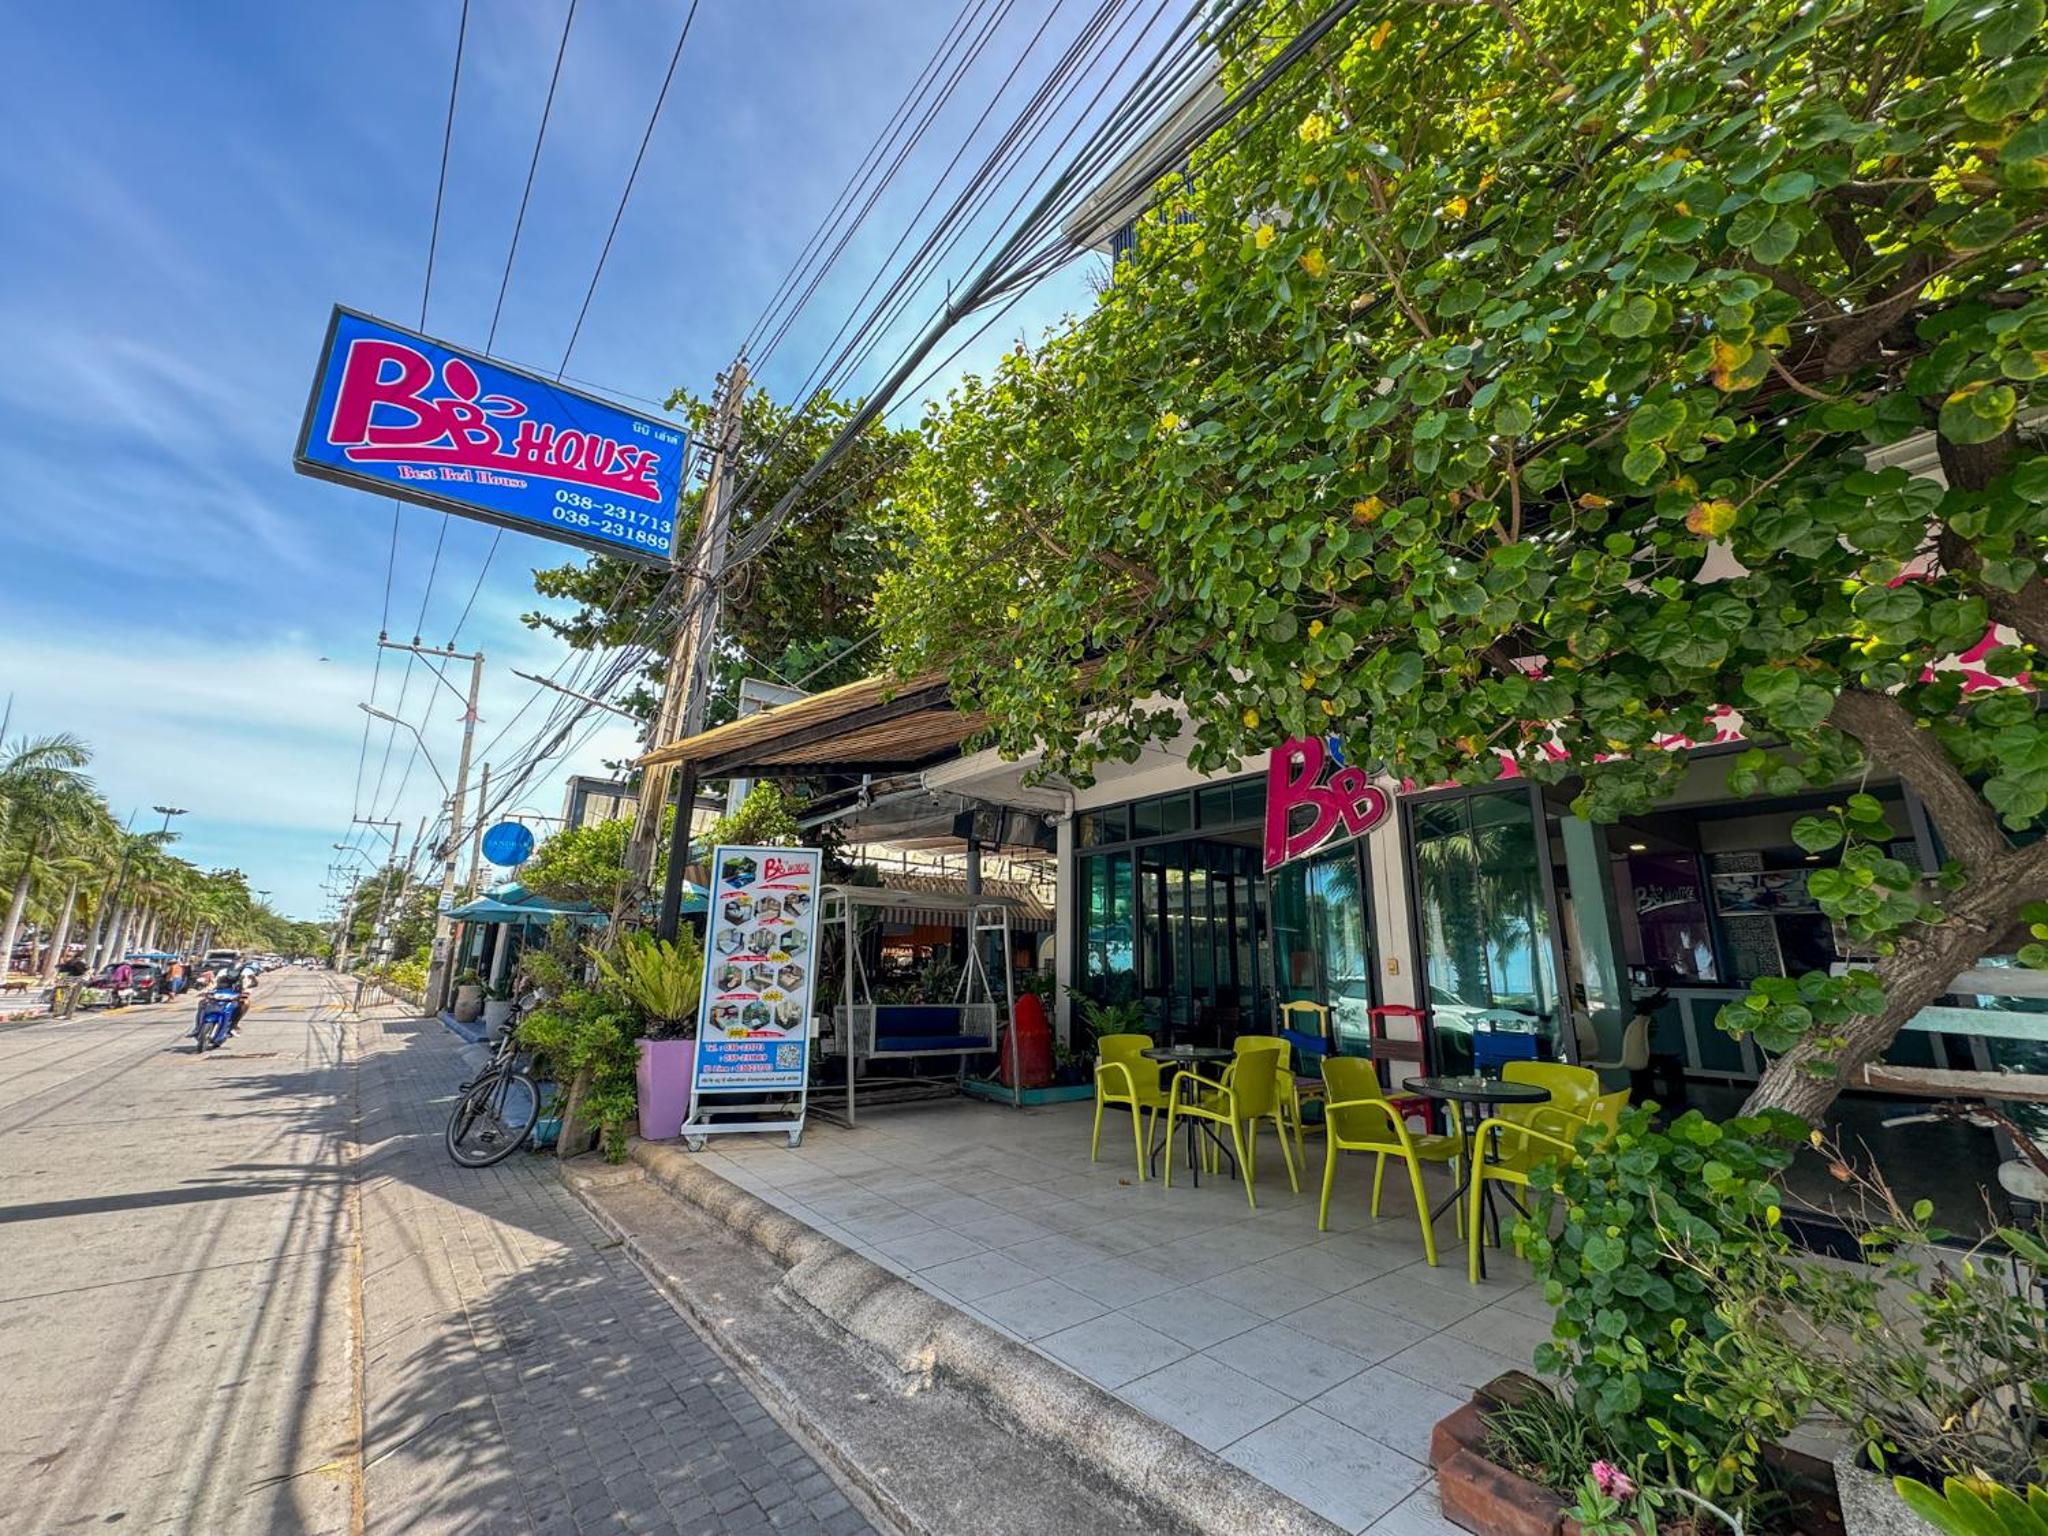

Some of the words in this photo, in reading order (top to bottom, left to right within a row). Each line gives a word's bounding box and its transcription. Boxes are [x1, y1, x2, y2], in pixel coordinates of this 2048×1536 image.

[512, 420, 660, 488] HOUSE
[398, 465, 437, 480] Best
[439, 467, 473, 482] Bed
[475, 470, 528, 489] House
[552, 506, 669, 550] 038-231889
[555, 489, 672, 533] 038-231713
